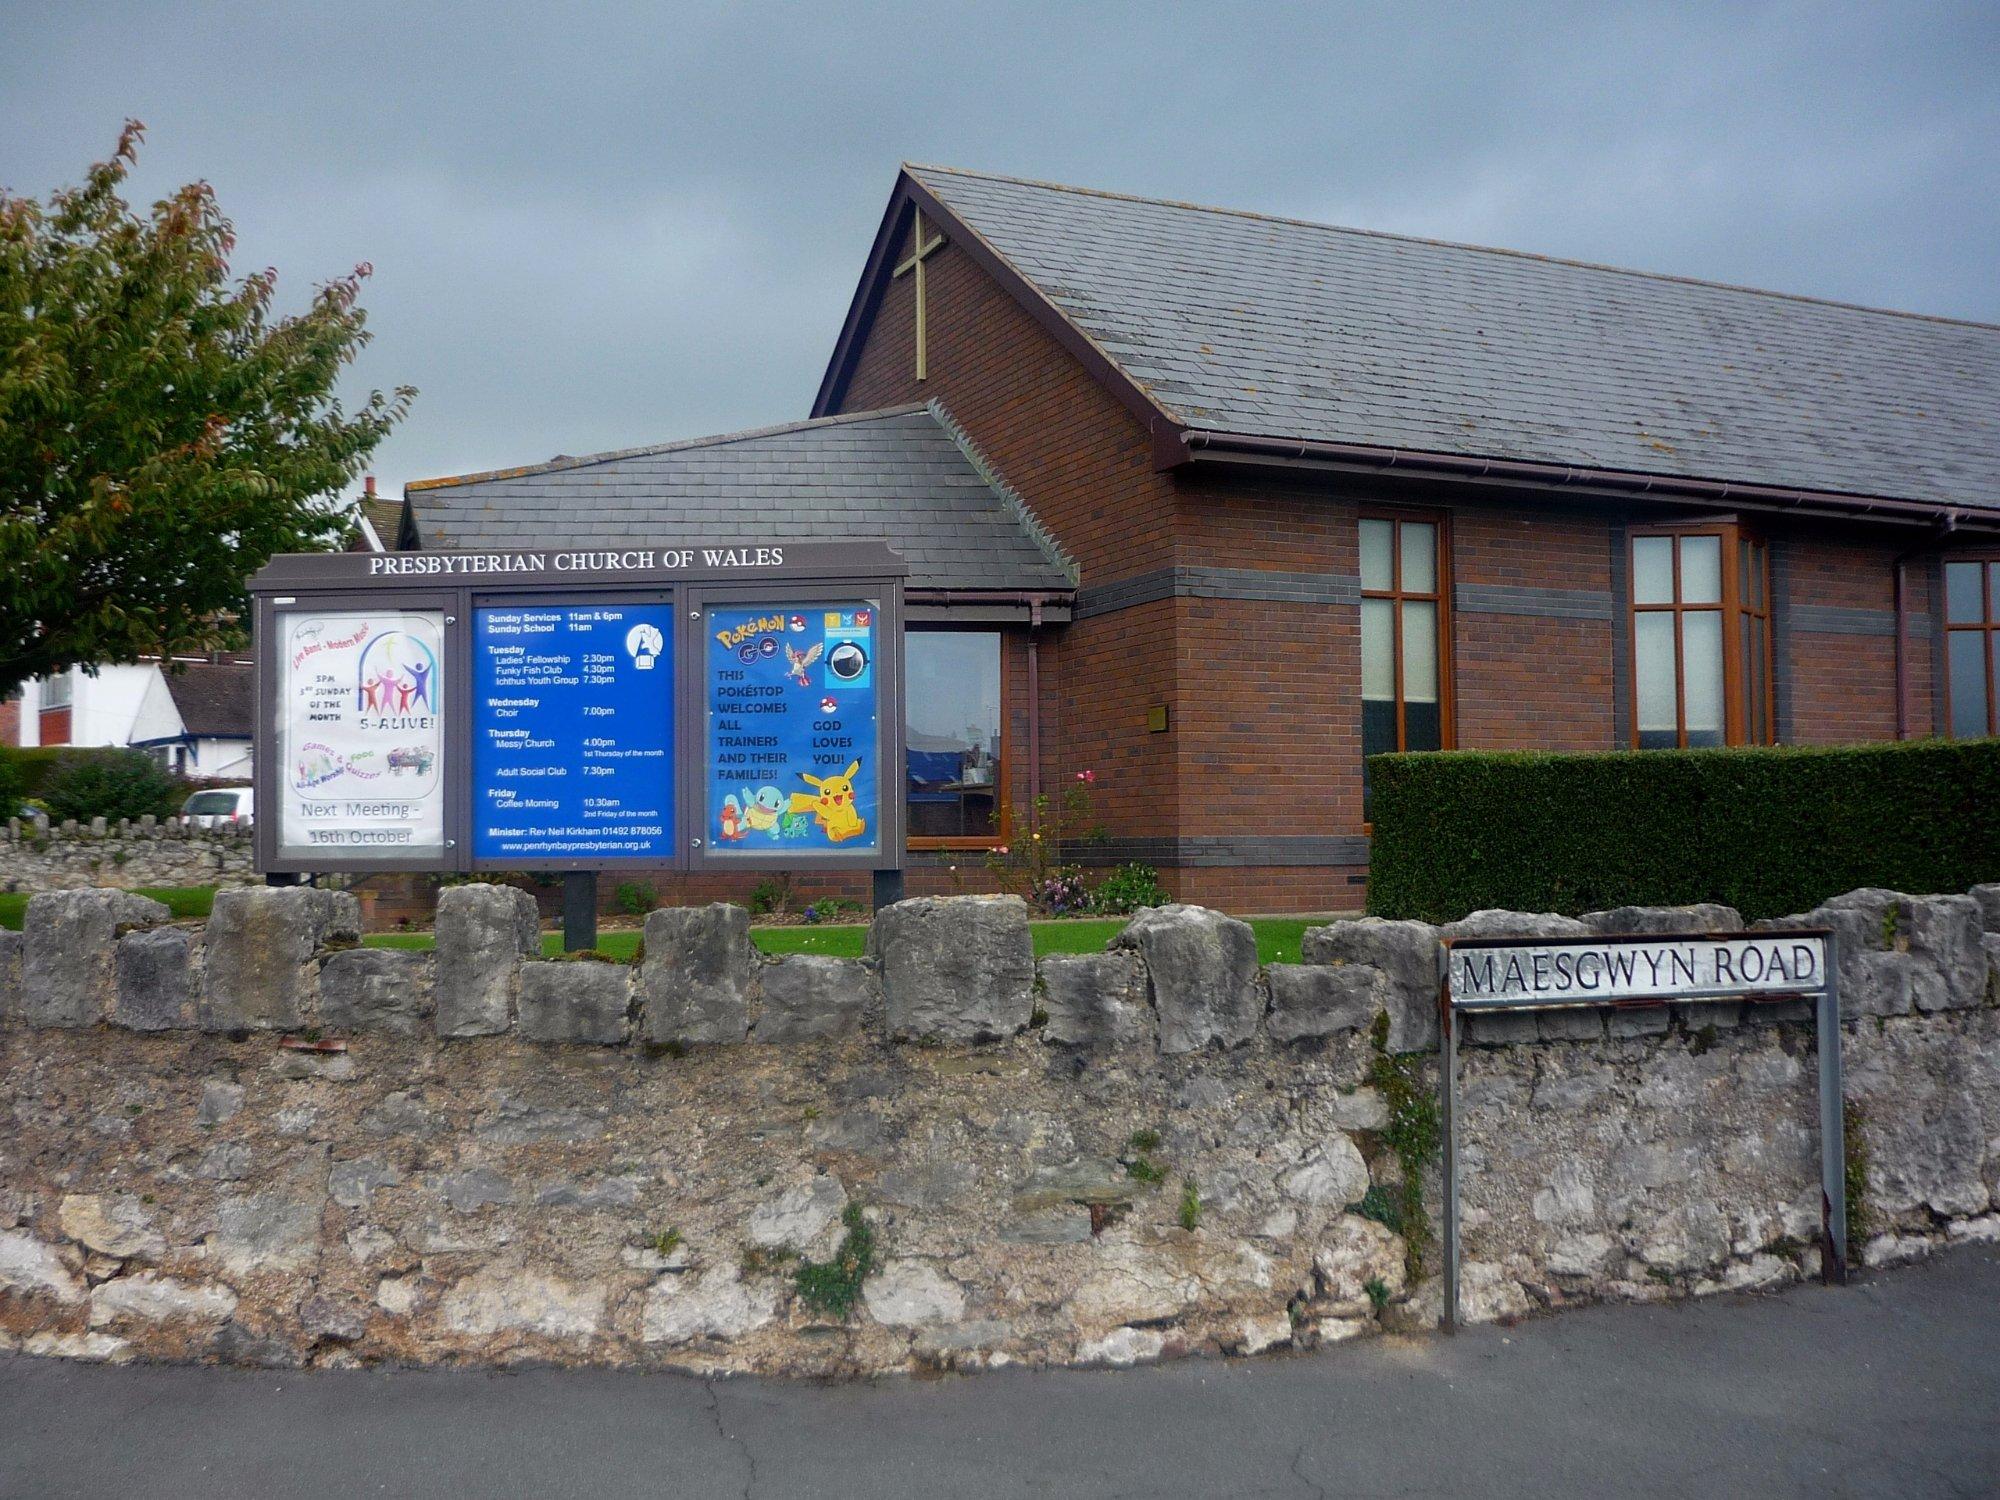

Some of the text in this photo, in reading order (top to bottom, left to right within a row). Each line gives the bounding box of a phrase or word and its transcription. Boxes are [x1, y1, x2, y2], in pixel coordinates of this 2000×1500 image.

[370, 548, 783, 574] PRESBYTERIAN CHURCH OF WALES
[488, 612, 622, 624] Sunday Services 11am & 6pm
[488, 623, 592, 634] Sunday School 11am
[303, 642, 321, 656] Band
[327, 639, 355, 649] Modern
[488, 646, 525, 655] Tuesday
[738, 637, 780, 665] GO
[496, 655, 614, 664] Ladies' Fellowship 2.30pm
[496, 667, 521, 676] Funky
[543, 666, 562, 674] Club
[583, 665, 614, 674] 4.30pm
[718, 671, 744, 680] THIS
[528, 677, 551, 685] Youth
[554, 676, 579, 686] Group
[584, 676, 614, 684] 7.30pm
[316, 688, 351, 696] SUNDAY
[718, 684, 784, 697] POKÉSTOP
[488, 699, 539, 708] Wednesday
[718, 703, 787, 713] WELCOMES
[496, 707, 614, 717] Choir 7.00pm
[718, 720, 741, 730] ALL
[813, 721, 841, 731] GOD
[489, 729, 530, 738] Thursday
[496, 738, 615, 749] Messy Church 4.00pm
[718, 737, 778, 747] TRAINERS
[813, 738, 853, 748] LOVES
[595, 750, 623, 758] Thursday
[718, 753, 787, 763] AND THEIR
[813, 754, 844, 764] YOU!
[497, 766, 614, 776] Adult Social Club 7.30pm
[718, 770, 777, 780] FAMILIES!
[488, 789, 516, 798] Friday
[525, 800, 559, 809] Morning
[302, 804, 337, 816] Next
[346, 803, 409, 818] Meeting
[489, 828, 527, 836] Minister:
[566, 827, 600, 835] Kirkham
[603, 827, 628, 835] 01492
[312, 831, 412, 843] 16th October
[502, 842, 651, 851] www.penrhynbaypresbyterian.org.uk
[1462, 945, 1815, 994] MAESGWYN ROAD
